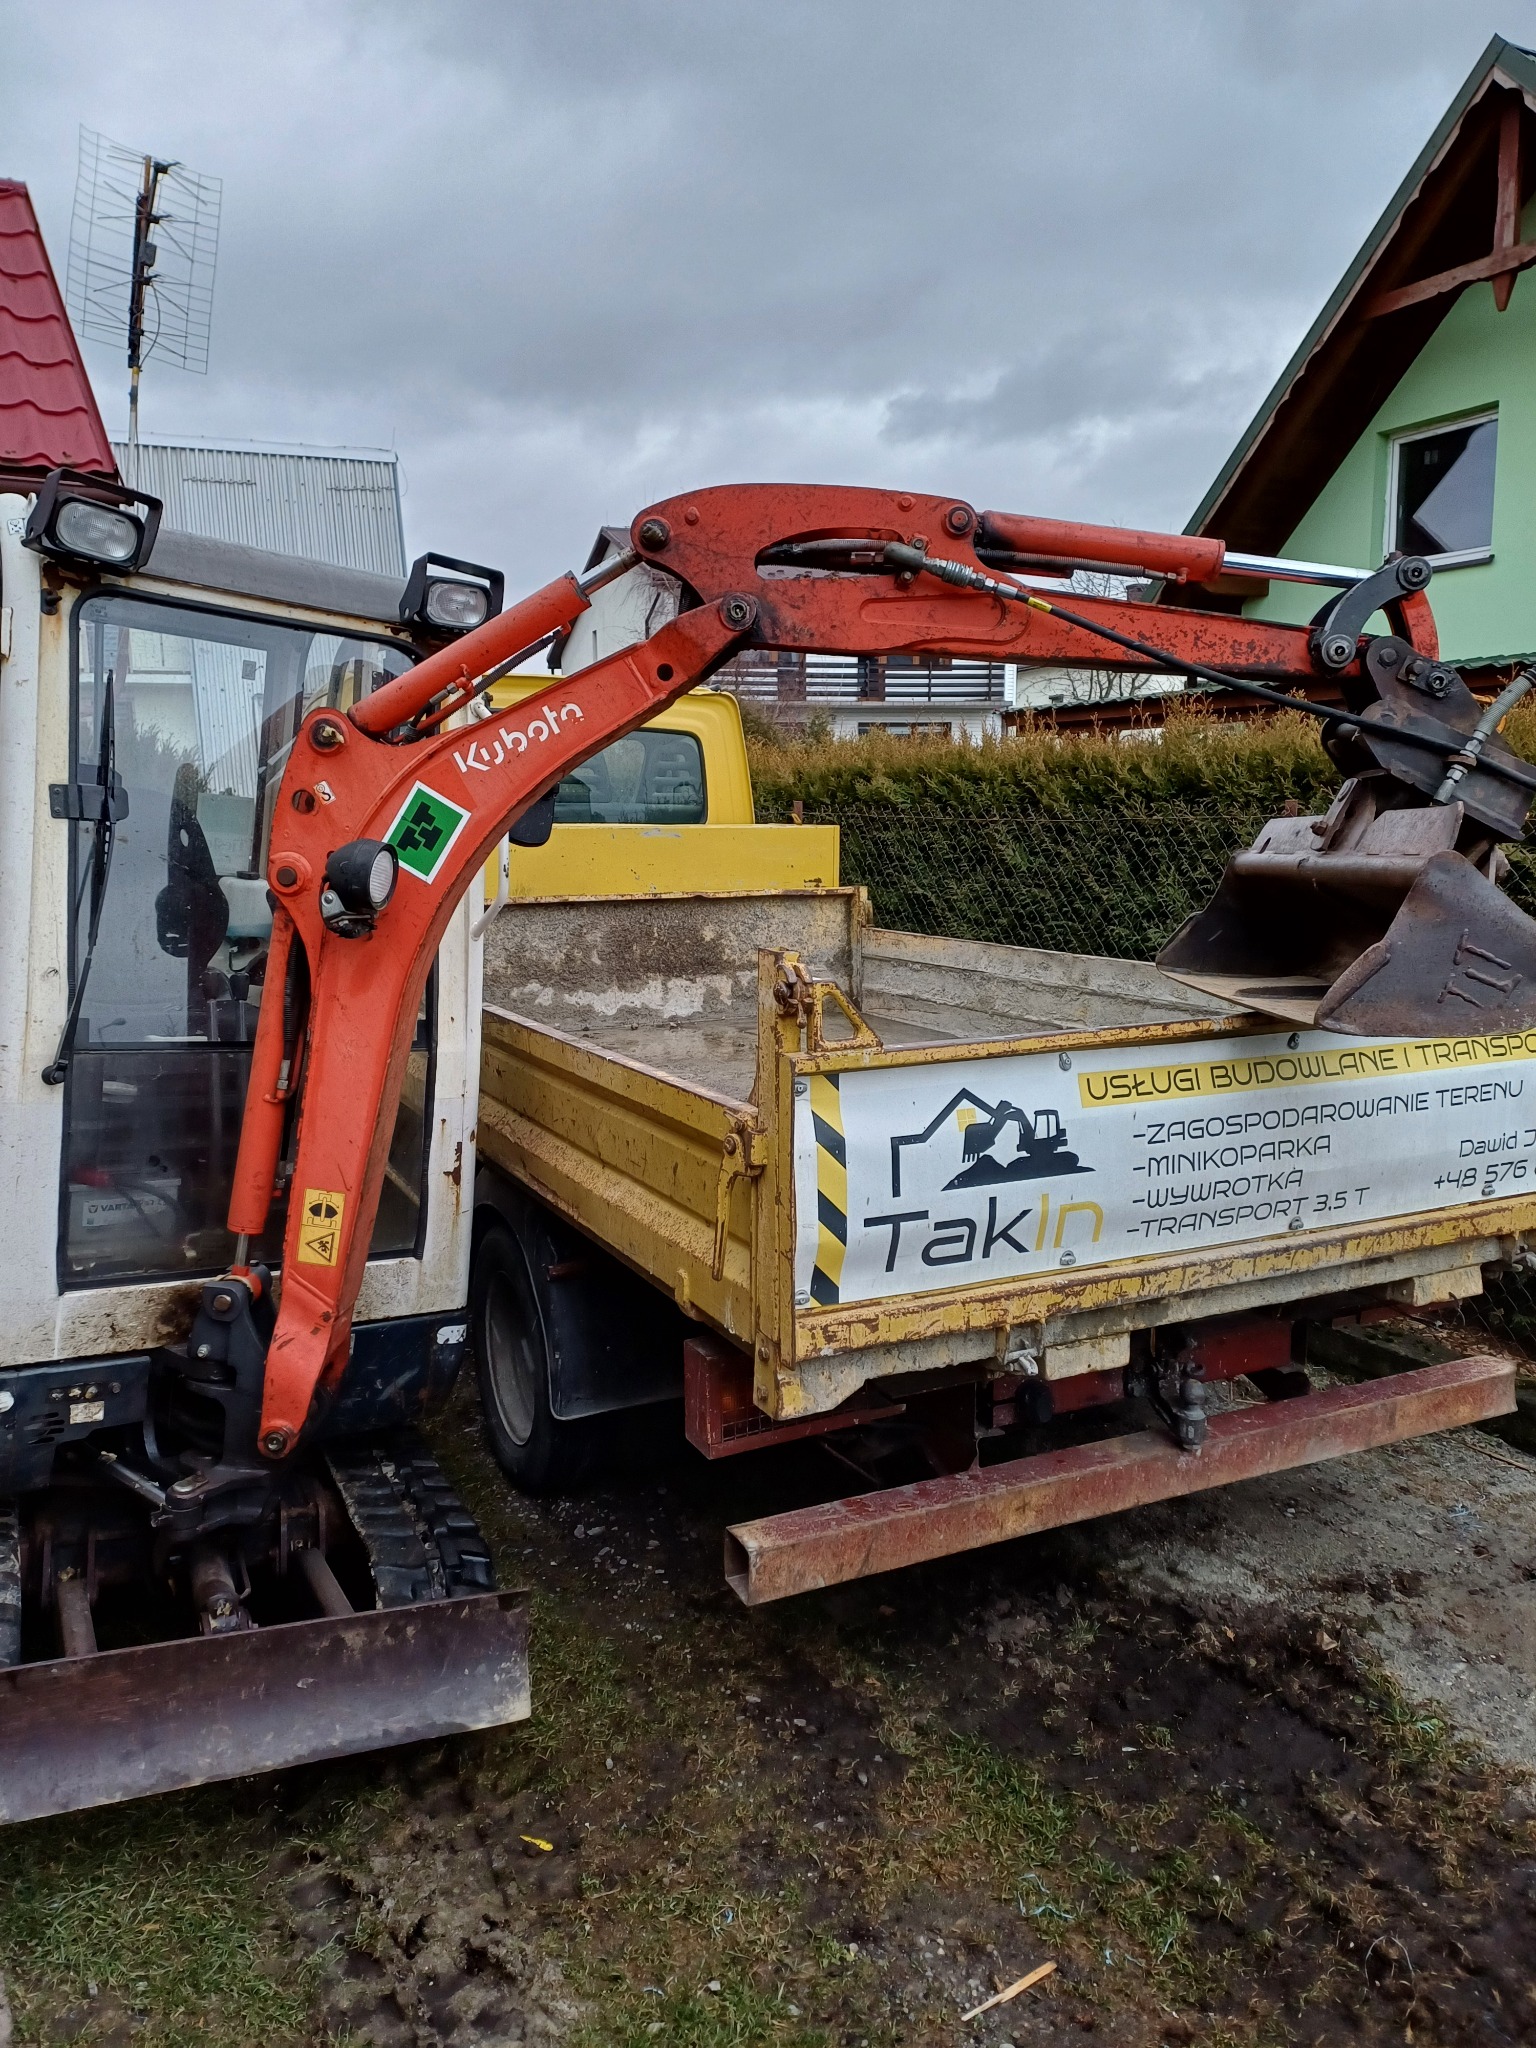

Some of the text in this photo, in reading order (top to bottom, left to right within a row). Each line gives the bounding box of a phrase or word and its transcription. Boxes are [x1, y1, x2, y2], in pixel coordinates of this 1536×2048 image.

[452, 702, 585, 773] Kubota
[1086, 1066, 1202, 1101] USŁUGI
[1210, 1048, 1397, 1088] BUDOWLANE
[1403, 1047, 1410, 1067] I
[1133, 1079, 1524, 1145] -ZAGOSPODAROWANIE TERENU
[1133, 1135, 1331, 1178] -MINIKOPARKA
[1459, 1131, 1518, 1158] Dawid
[1132, 1169, 1304, 1209] -WYWROTKA
[1434, 1159, 1529, 1189] +48 576
[1127, 1196, 1309, 1238] -TRANSPORT
[1354, 1186, 1371, 1206] T
